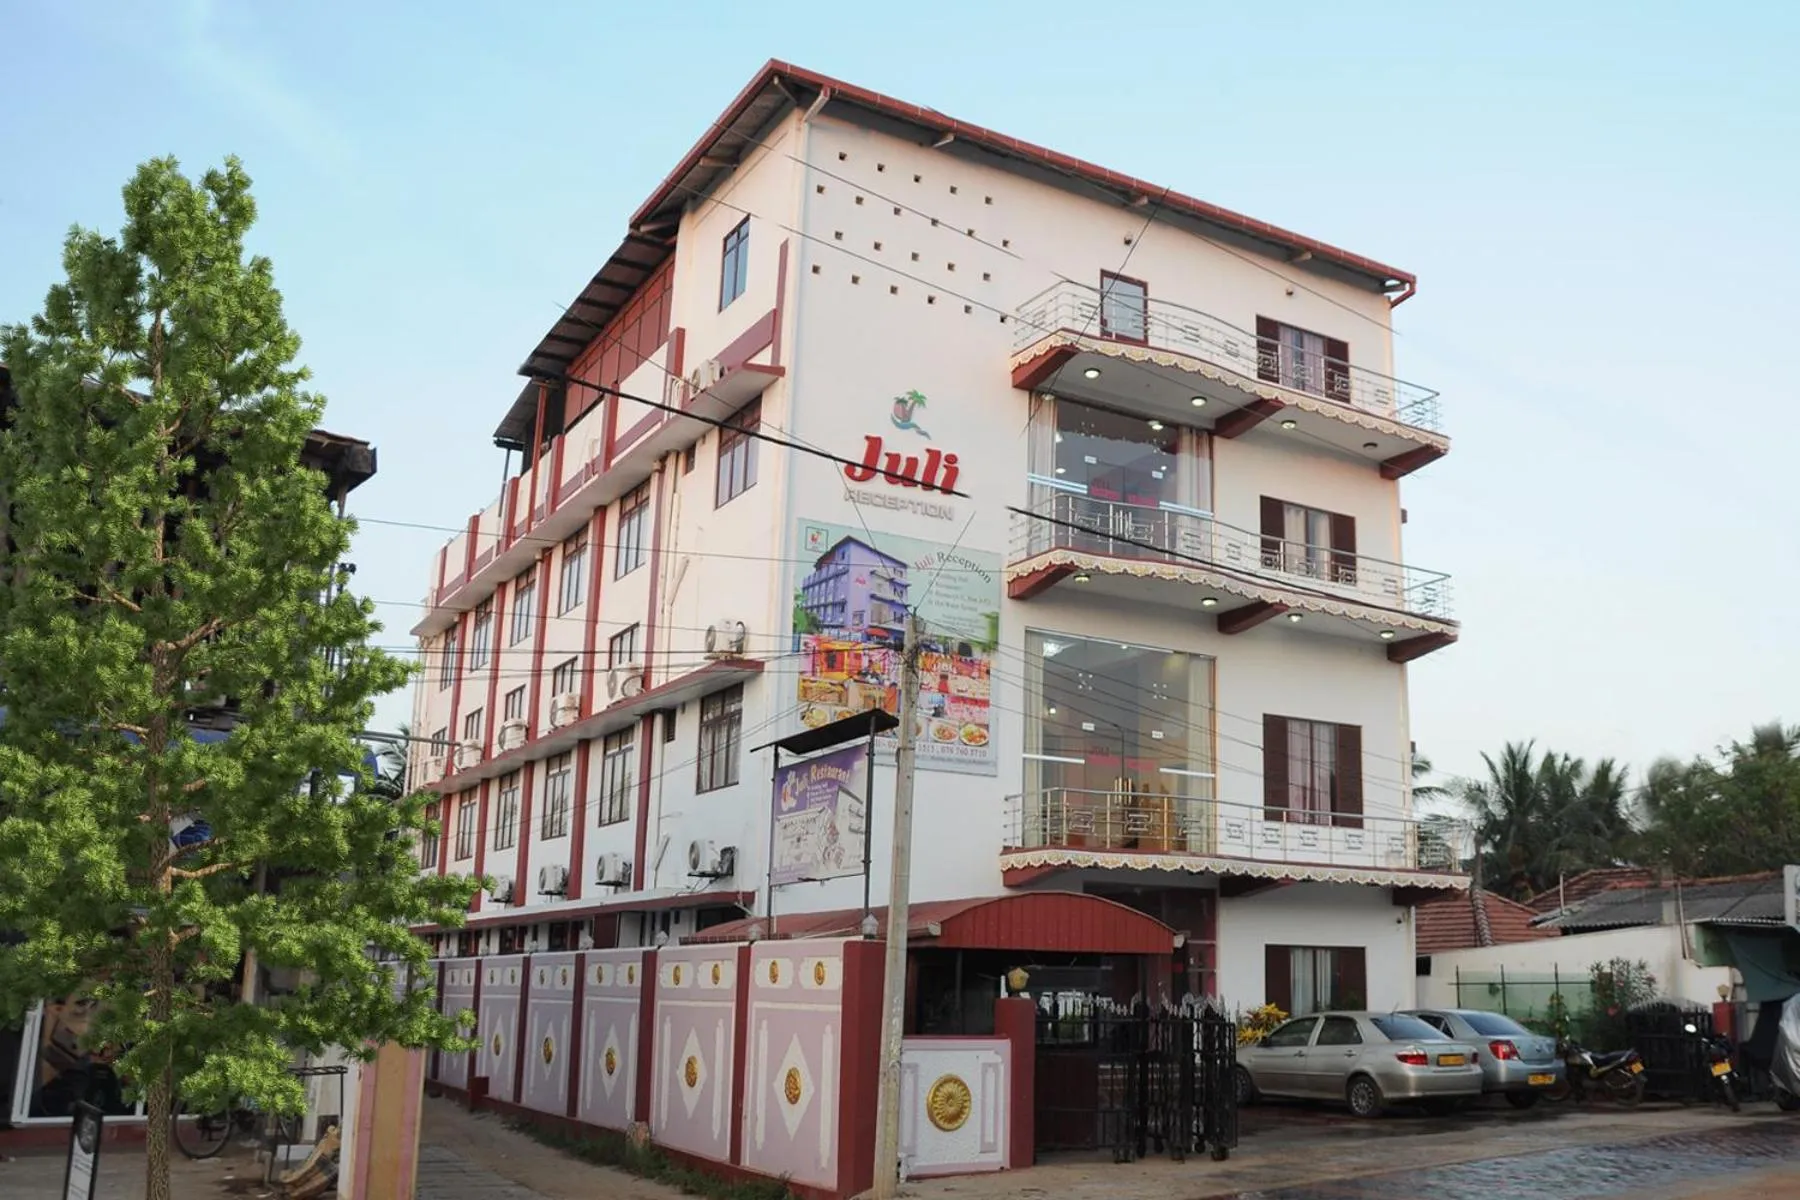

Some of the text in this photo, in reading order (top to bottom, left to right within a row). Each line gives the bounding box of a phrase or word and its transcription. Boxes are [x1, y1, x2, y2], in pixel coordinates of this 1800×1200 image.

[844, 435, 960, 495] Juli
[844, 489, 955, 521] RECEPTION
[936, 551, 992, 583] Reception
